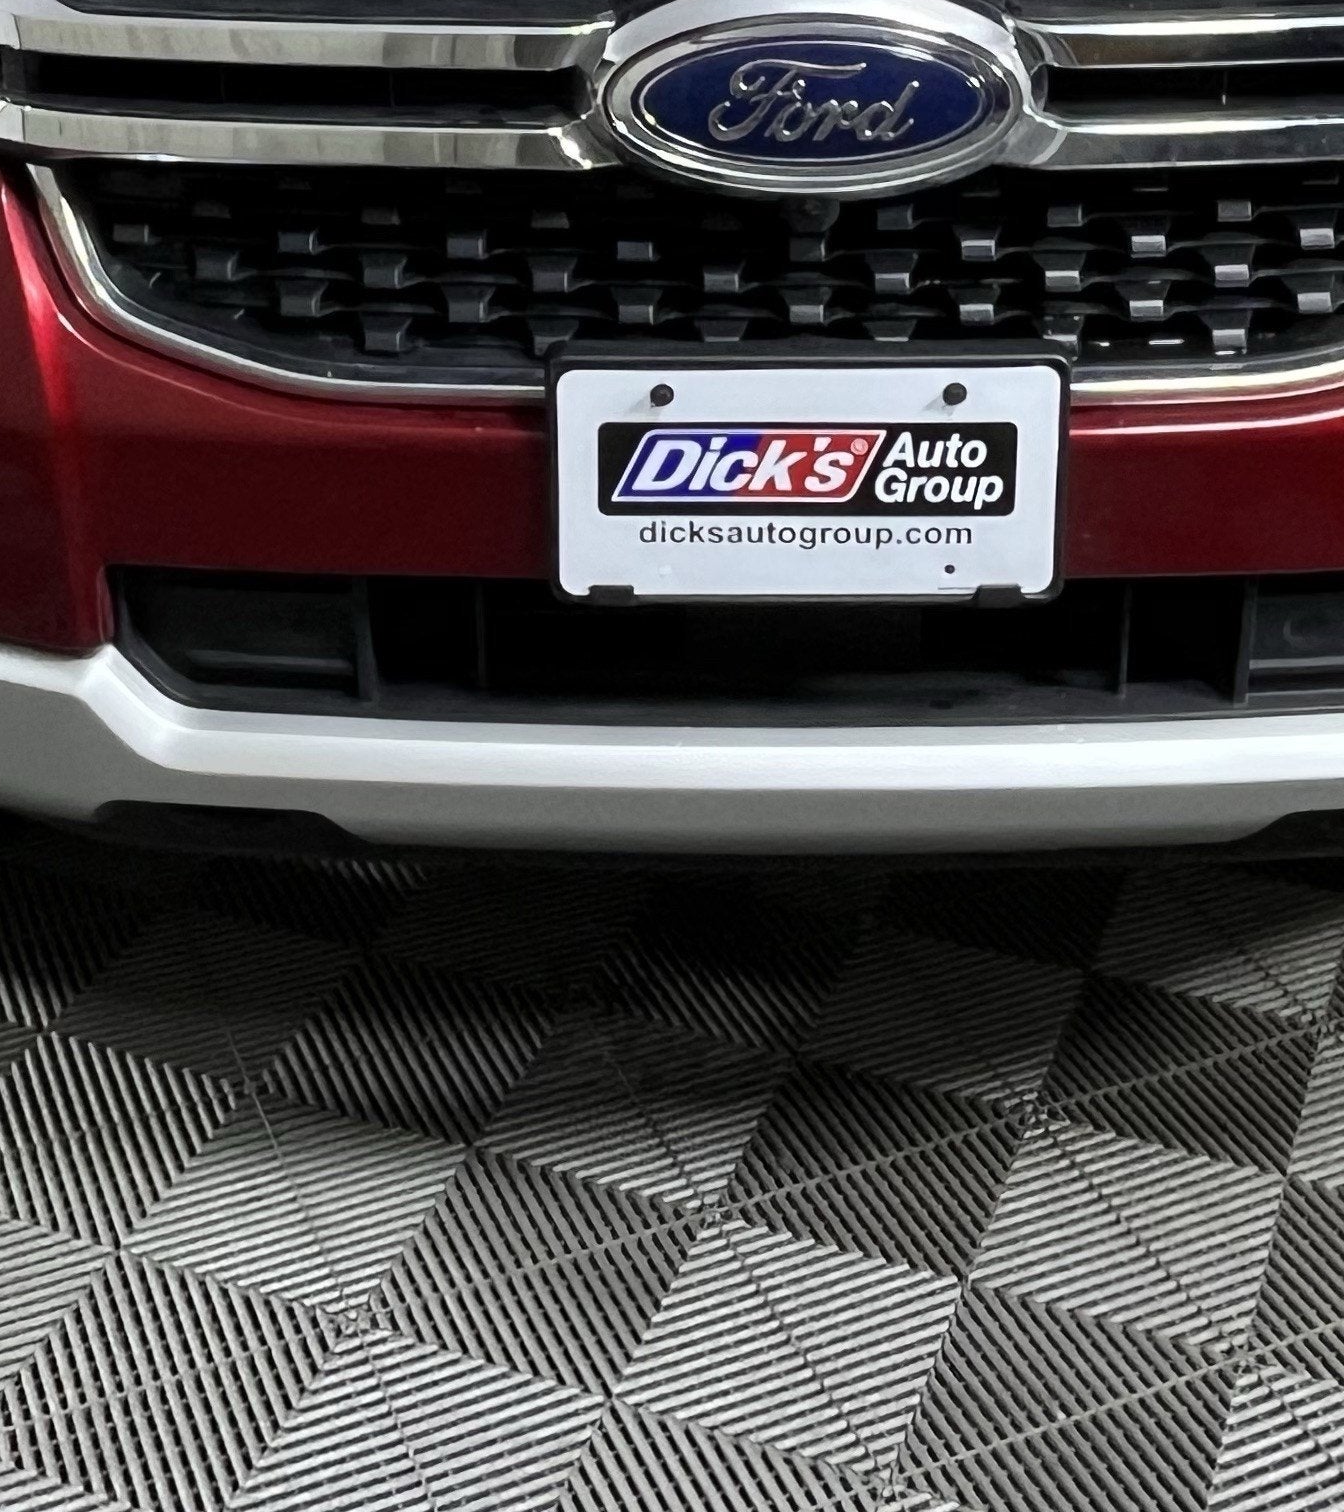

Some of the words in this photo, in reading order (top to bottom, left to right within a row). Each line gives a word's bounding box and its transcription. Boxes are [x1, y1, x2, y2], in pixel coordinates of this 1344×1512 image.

[707, 58, 920, 143] Ford
[631, 436, 854, 492] Dick's
[882, 431, 988, 469] Auto
[873, 468, 1005, 511] Group
[638, 519, 974, 550] dicksautogroup.com
